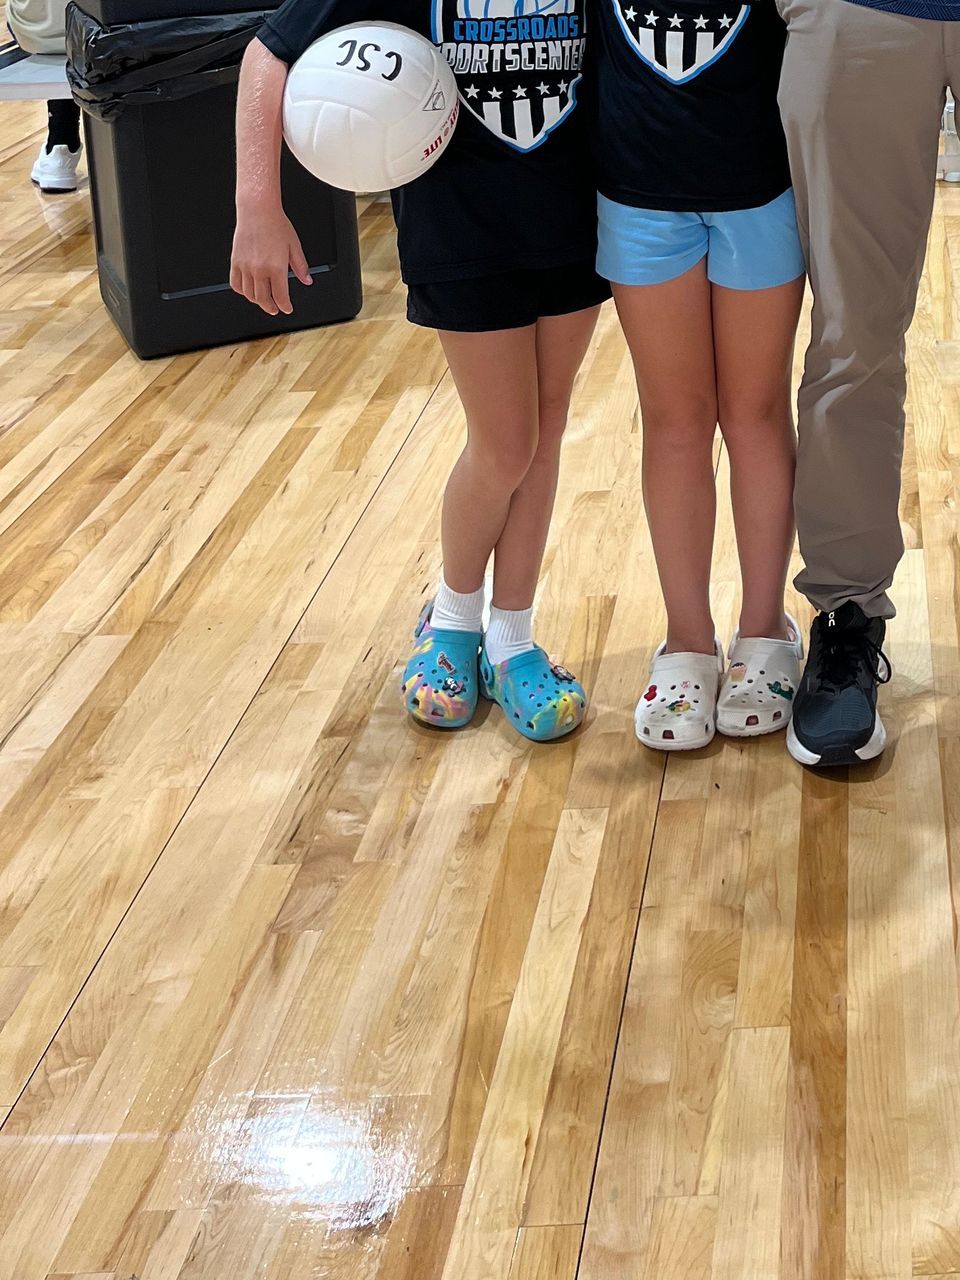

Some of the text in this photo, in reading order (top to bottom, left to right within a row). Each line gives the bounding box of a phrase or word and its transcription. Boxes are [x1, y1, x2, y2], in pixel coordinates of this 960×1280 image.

[453, 15, 579, 42] CROSSROADS
[336, 39, 403, 81] CSC
[439, 37, 586, 74] PORTSCENTER
[423, 135, 443, 158] LITE
